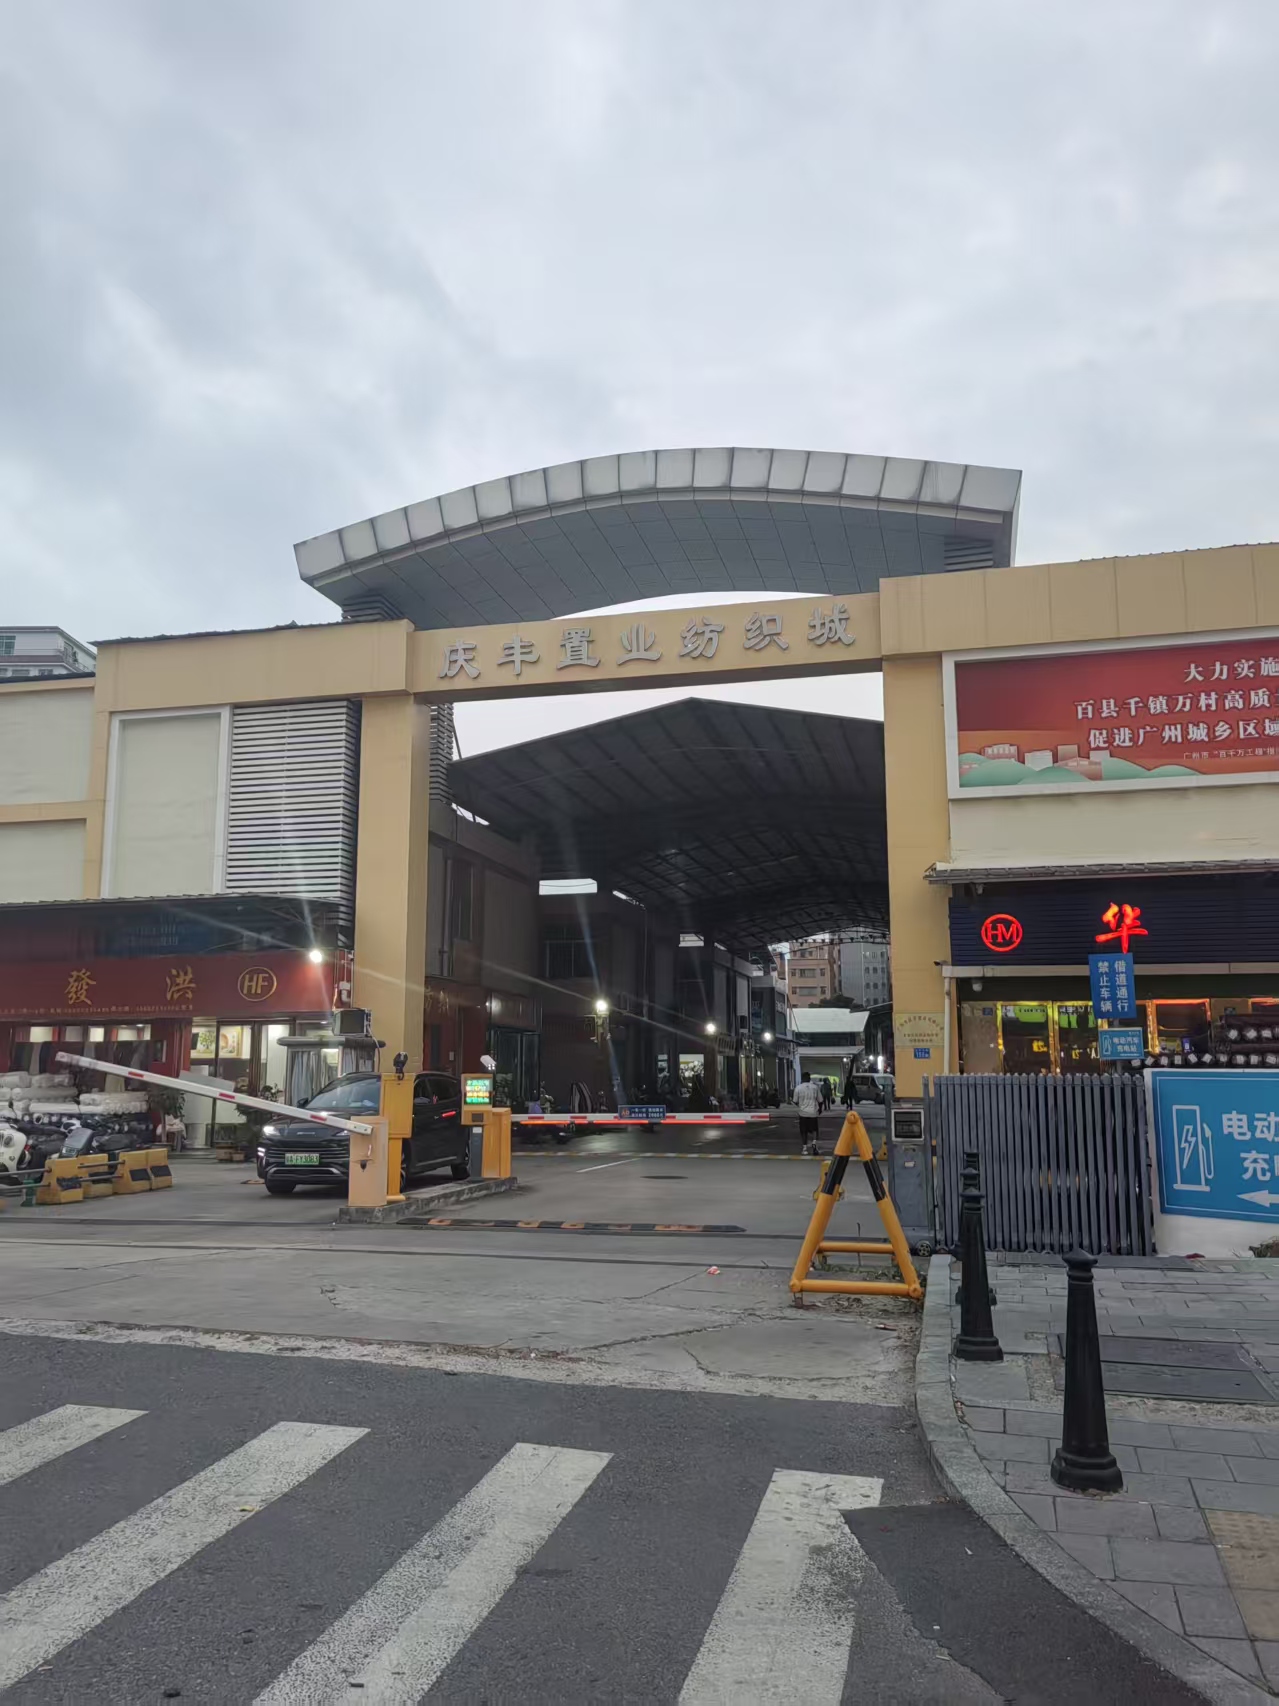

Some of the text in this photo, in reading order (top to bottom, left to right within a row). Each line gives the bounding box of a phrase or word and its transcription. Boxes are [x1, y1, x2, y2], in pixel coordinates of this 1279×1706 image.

[438, 603, 856, 679] 庆丰置业纺织城
[1184, 657, 1279, 683] 大力实施
[1095, 902, 1148, 953] 华
[1098, 961, 1113, 1013] 禁止车辆
[1114, 960, 1129, 1012] 借道通行
[1240, 1150, 1279, 1181] 充
